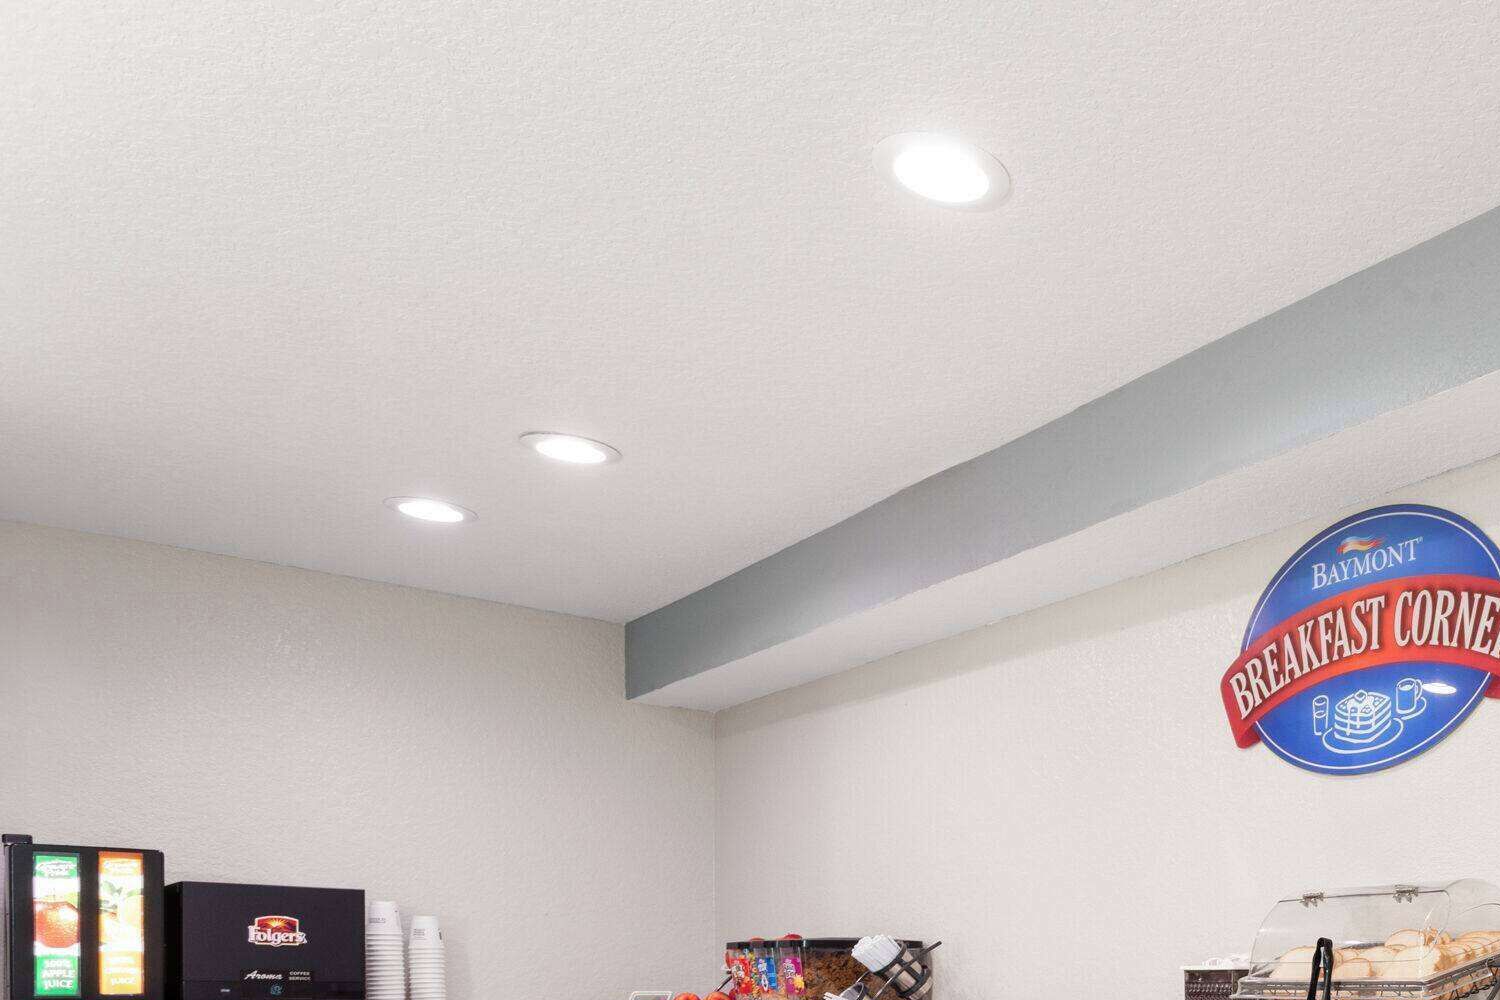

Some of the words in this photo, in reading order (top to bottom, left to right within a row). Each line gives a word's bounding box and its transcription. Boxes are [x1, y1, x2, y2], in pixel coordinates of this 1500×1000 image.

[1312, 539, 1419, 590] BAYMONT
[1230, 596, 1385, 720] BREAKFAST
[248, 925, 306, 947] Folgers
[41, 968, 76, 978] APPLE
[244, 970, 284, 980] Aroma
[43, 979, 73, 989] JUICE
